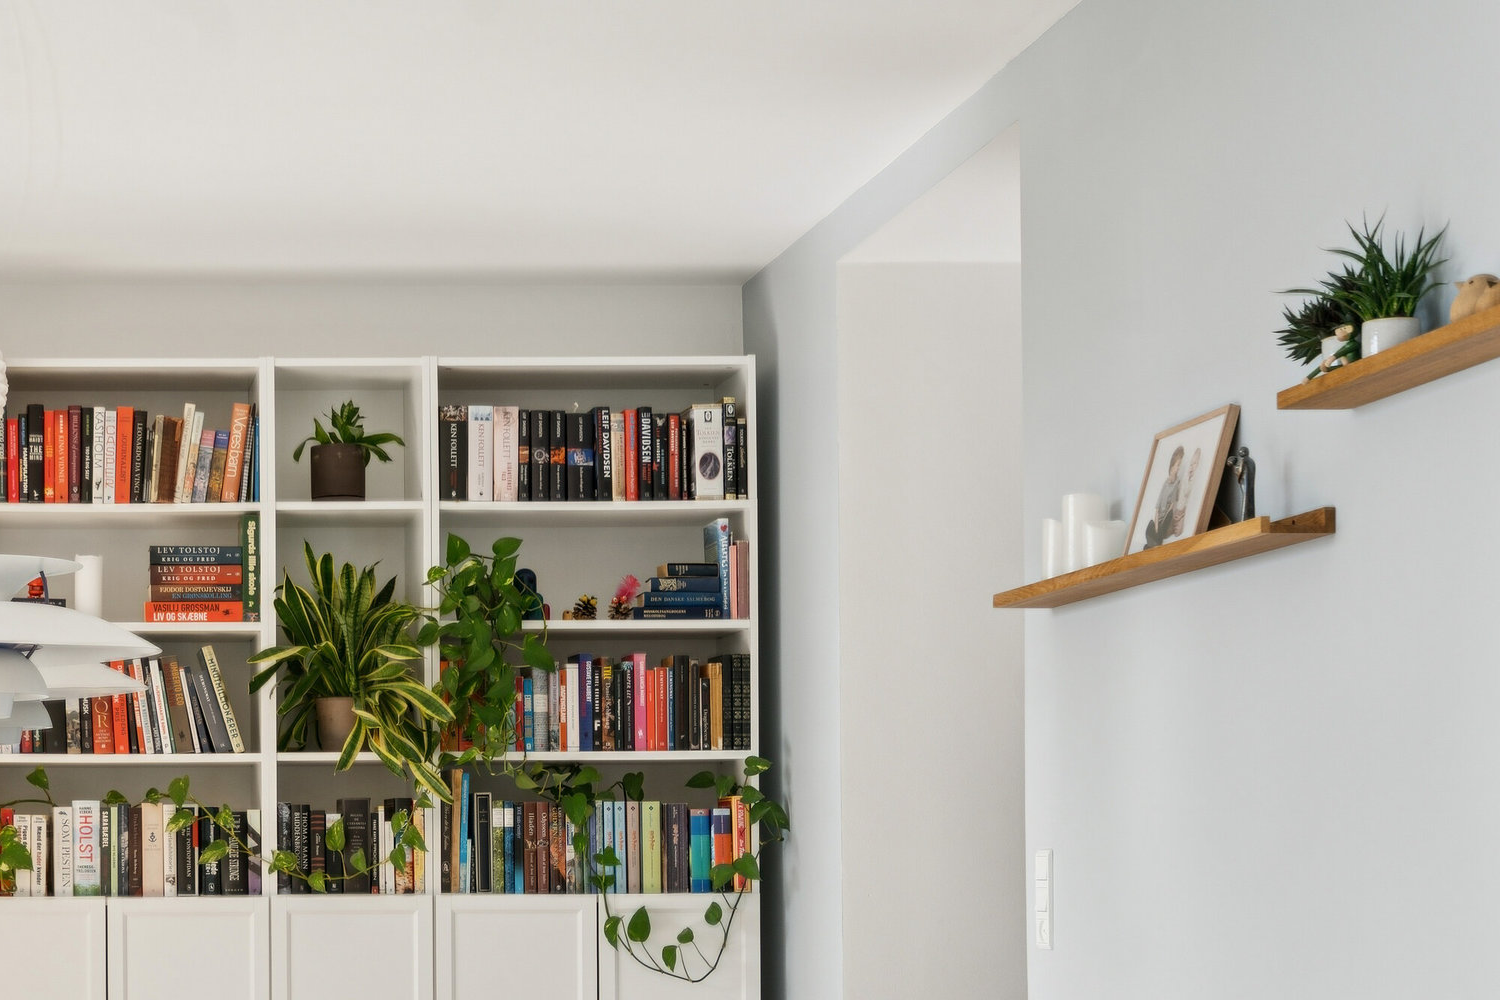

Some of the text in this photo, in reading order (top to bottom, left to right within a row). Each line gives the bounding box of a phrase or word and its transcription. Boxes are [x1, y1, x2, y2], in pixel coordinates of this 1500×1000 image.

[30, 445, 43, 453] THE
[94, 411, 104, 469] KASTHOLM
[120, 433, 128, 482] JOURNALIST
[133, 423, 143, 494] LEONARDO DA VINCI
[226, 415, 248, 478] Vores barn
[502, 428, 510, 458] FOLLETT
[602, 410, 610, 478] LEIF DAVIDSEN
[642, 418, 651, 462] DAVIDSEN
[247, 520, 256, 596] Sigurds lille skole
[153, 604, 220, 612] VASILIJ GROSSMAN
[153, 613, 208, 621] LIV OG SKÆBNE
[170, 662, 184, 706] UMBERTO ECO
[199, 674, 210, 702] HEMINGWAY
[208, 658, 239, 739] MINUTMILLIONÆRER
[62, 819, 71, 888] SOM PESTEN
[79, 816, 93, 862] HOLST
[229, 859, 239, 881] STRUNGE
